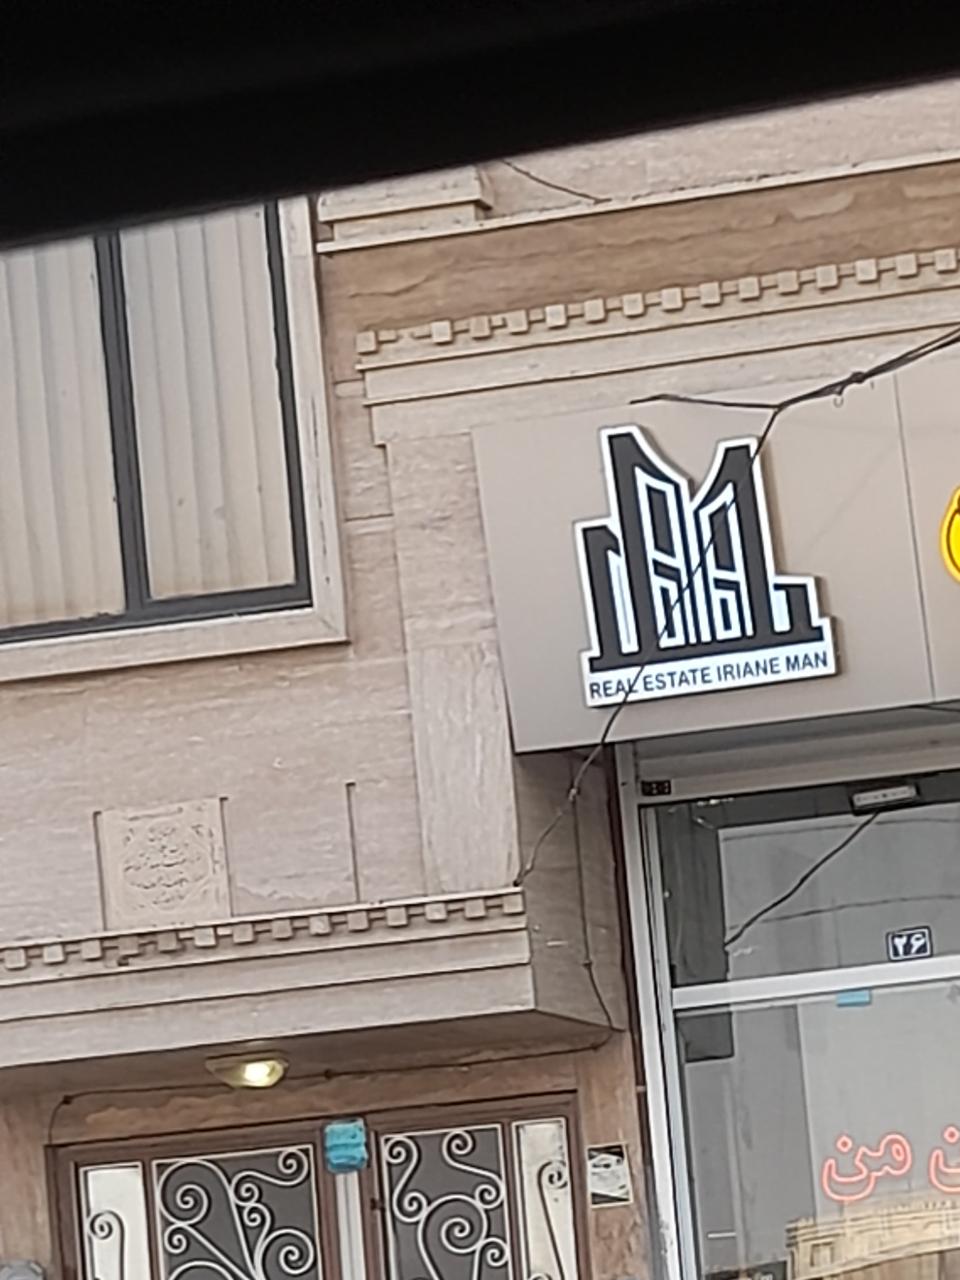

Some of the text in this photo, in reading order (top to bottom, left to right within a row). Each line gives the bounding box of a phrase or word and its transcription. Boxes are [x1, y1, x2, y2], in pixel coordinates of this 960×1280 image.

[589, 651, 829, 699] REAL ESTATE IRIANE MAN
[893, 934, 926, 956] ۲۶
[821, 1131, 914, 1202] من
